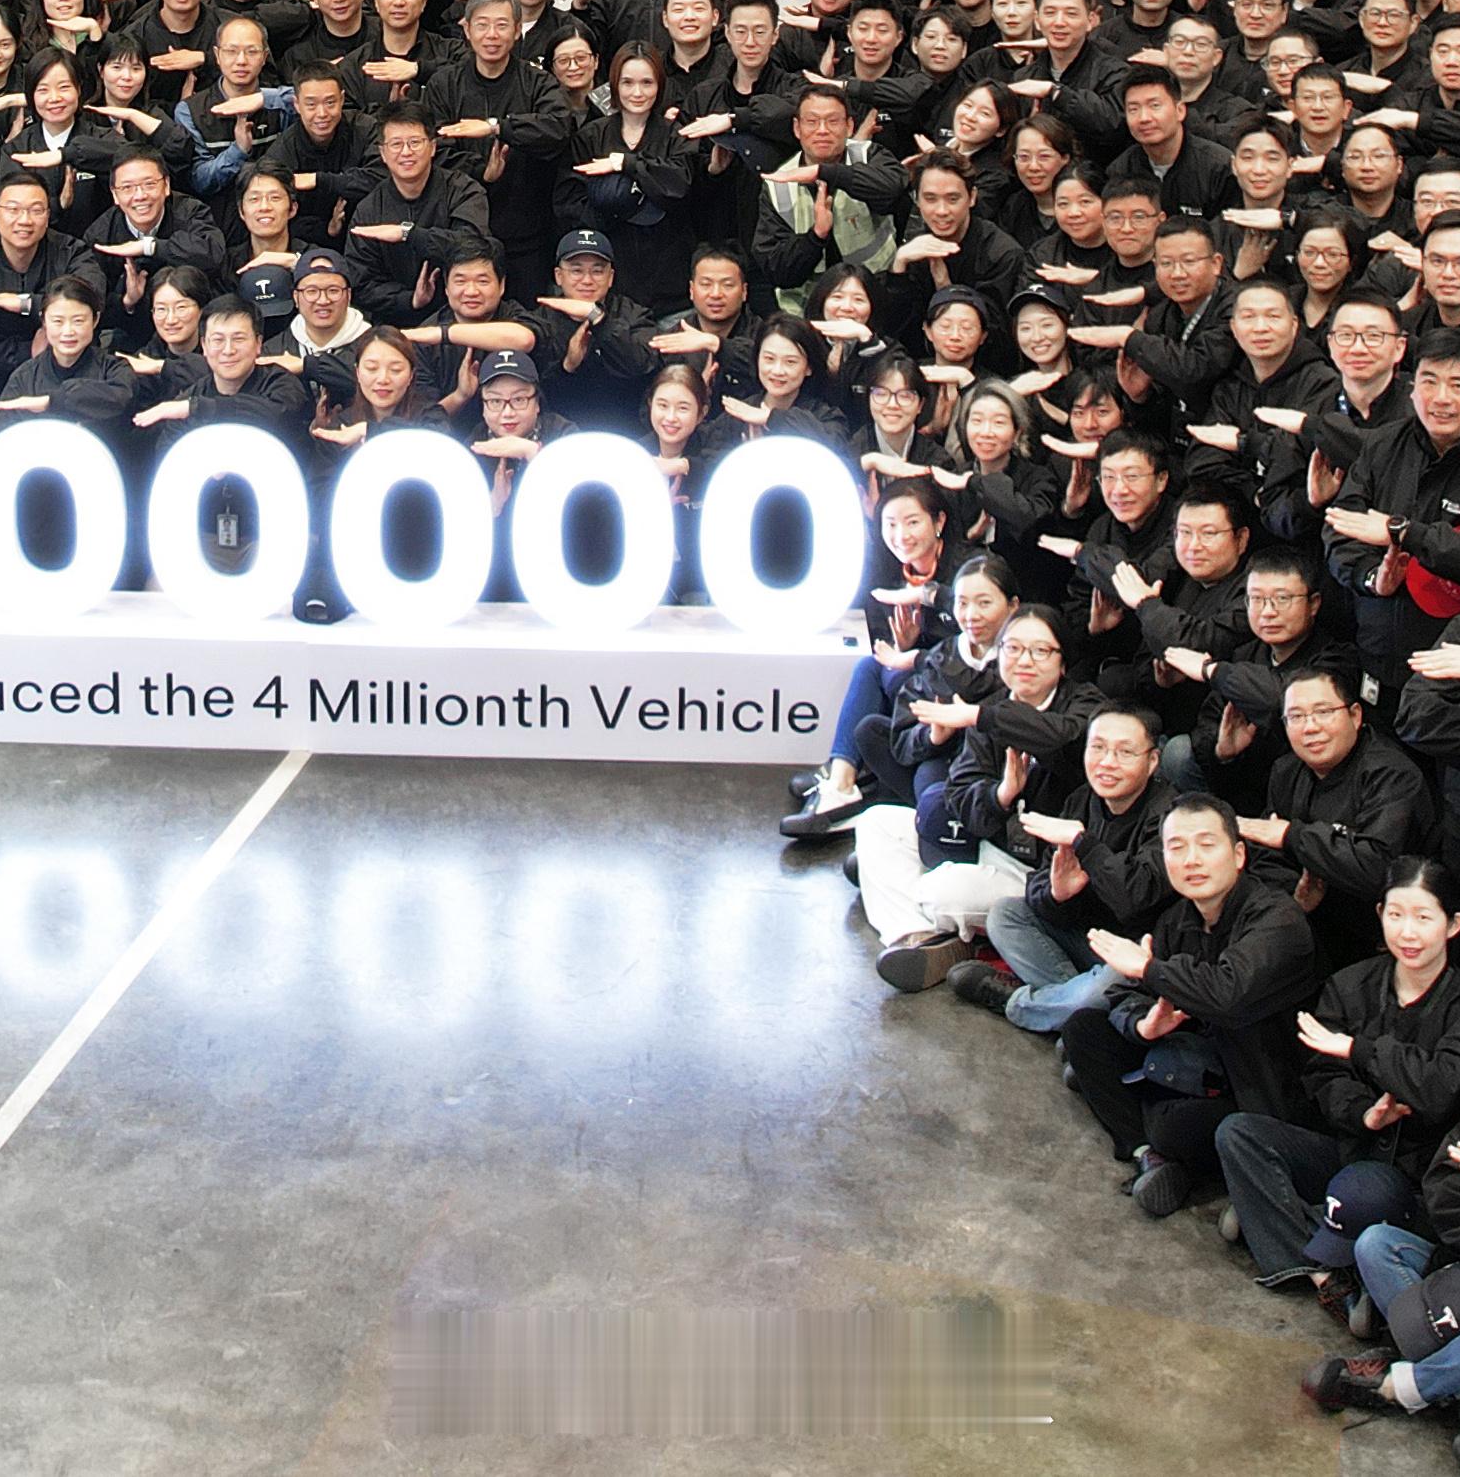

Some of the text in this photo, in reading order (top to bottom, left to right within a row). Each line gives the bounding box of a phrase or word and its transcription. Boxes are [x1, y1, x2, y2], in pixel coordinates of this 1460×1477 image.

[139, 673, 234, 718] the
[253, 676, 288, 719] 4
[309, 679, 570, 728] Millionth
[590, 685, 820, 734] Vehicle
